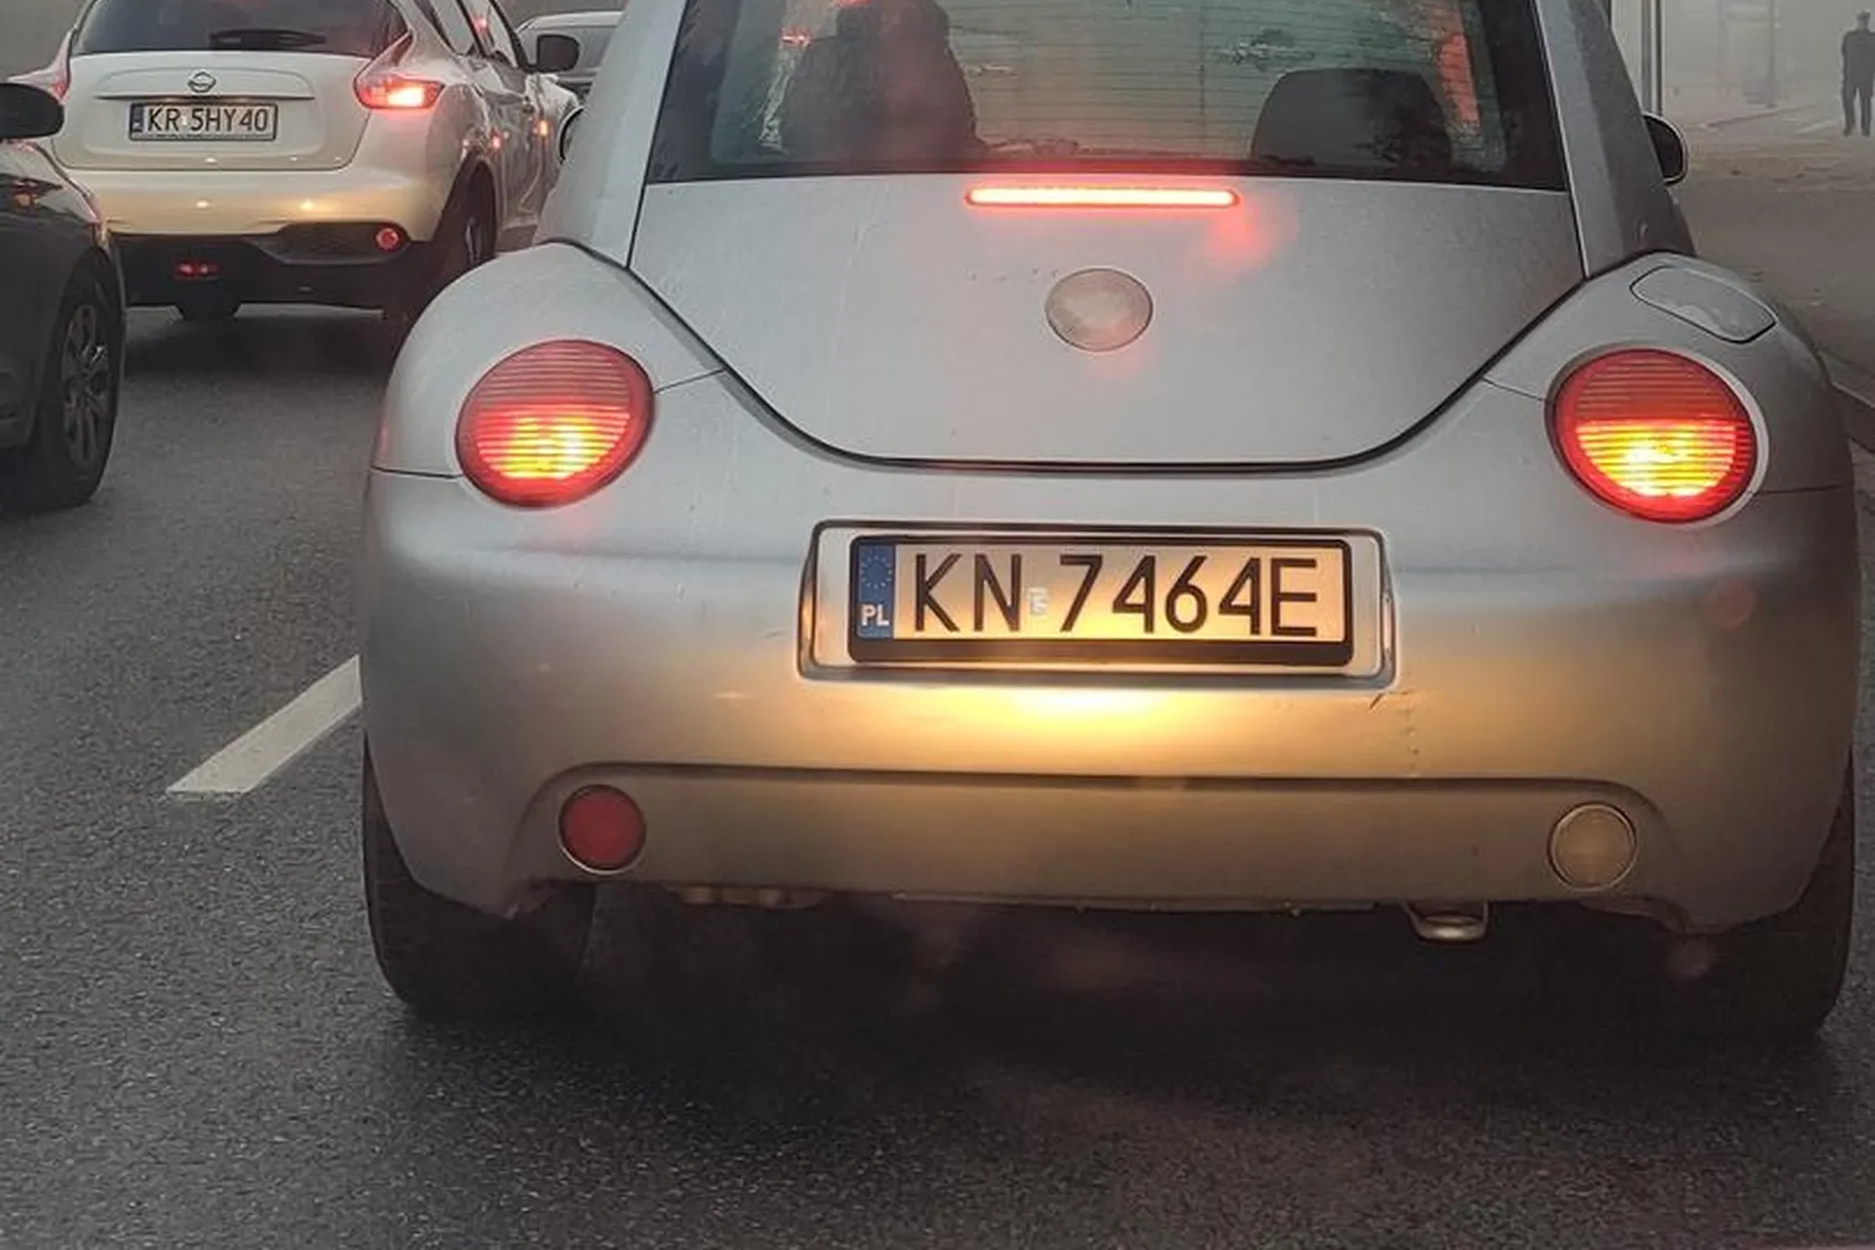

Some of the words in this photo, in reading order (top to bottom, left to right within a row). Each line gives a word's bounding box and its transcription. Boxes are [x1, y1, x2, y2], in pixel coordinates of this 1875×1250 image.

[148, 108, 181, 132] KR
[190, 108, 268, 132] 5HY40
[914, 552, 1023, 633] KN
[1058, 554, 1318, 637] 7464E
[861, 604, 891, 627] PL
